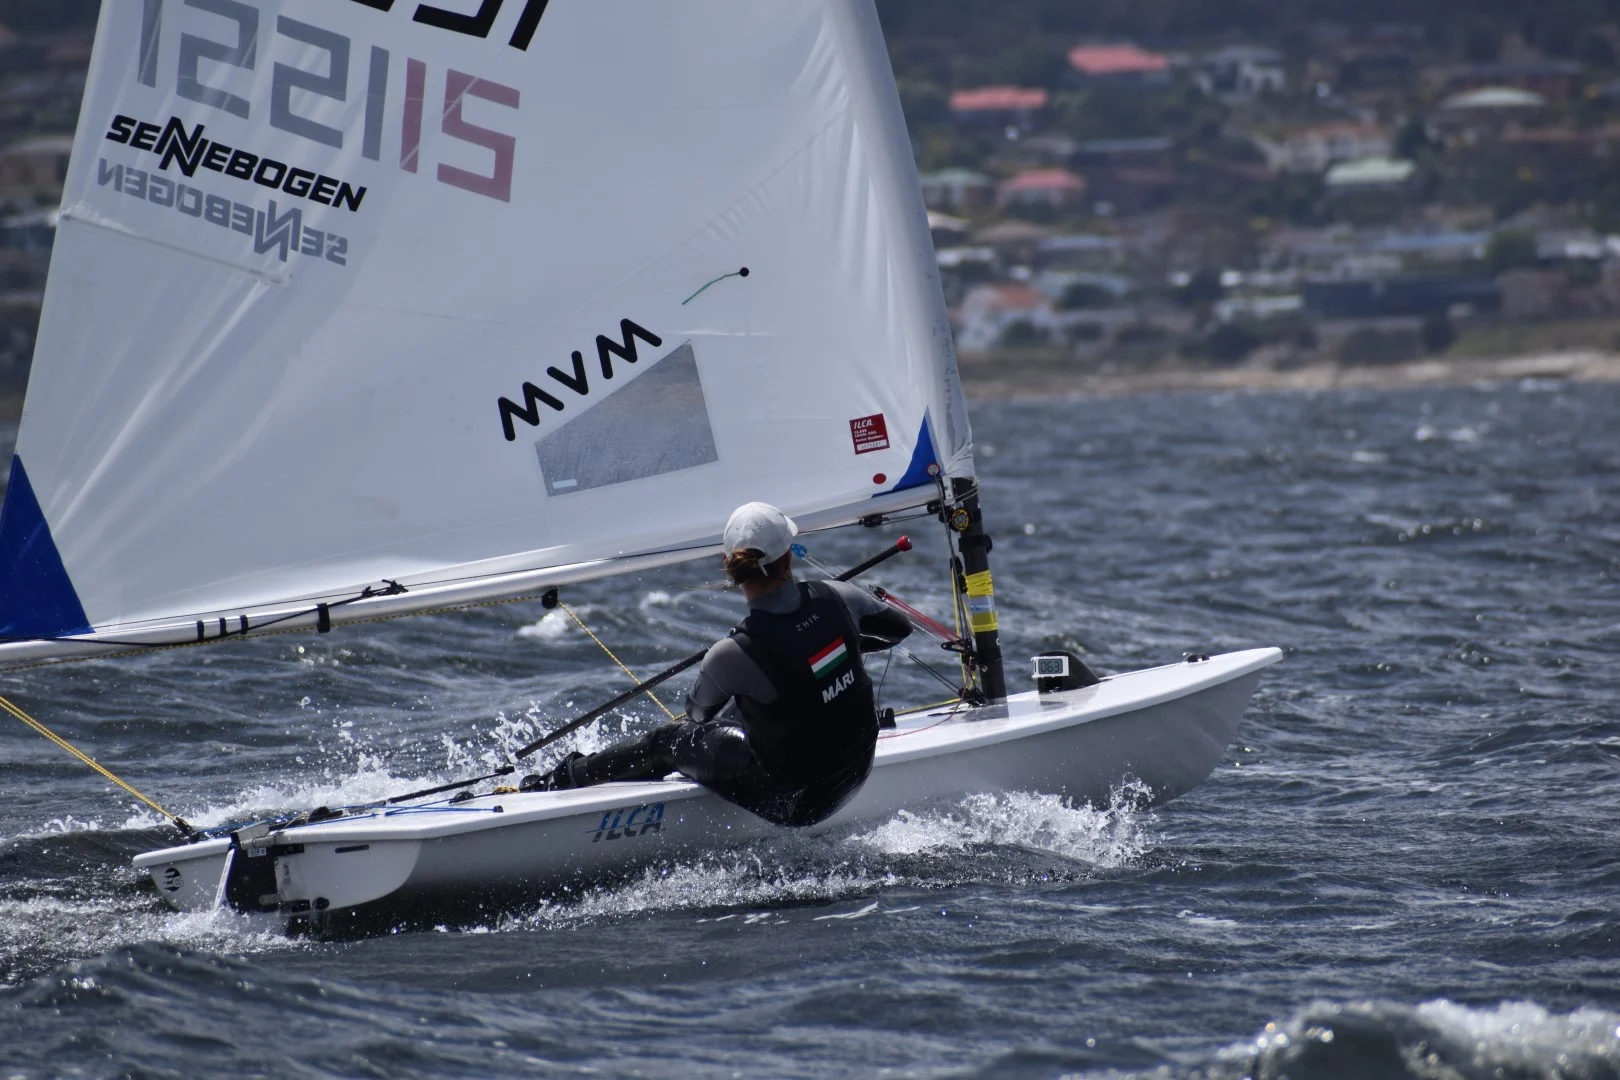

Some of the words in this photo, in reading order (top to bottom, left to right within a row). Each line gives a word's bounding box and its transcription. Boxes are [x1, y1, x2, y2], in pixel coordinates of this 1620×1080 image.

[497, 318, 662, 441] MVM
[854, 419, 872, 429] ILCA
[795, 613, 820, 632] ZHIK
